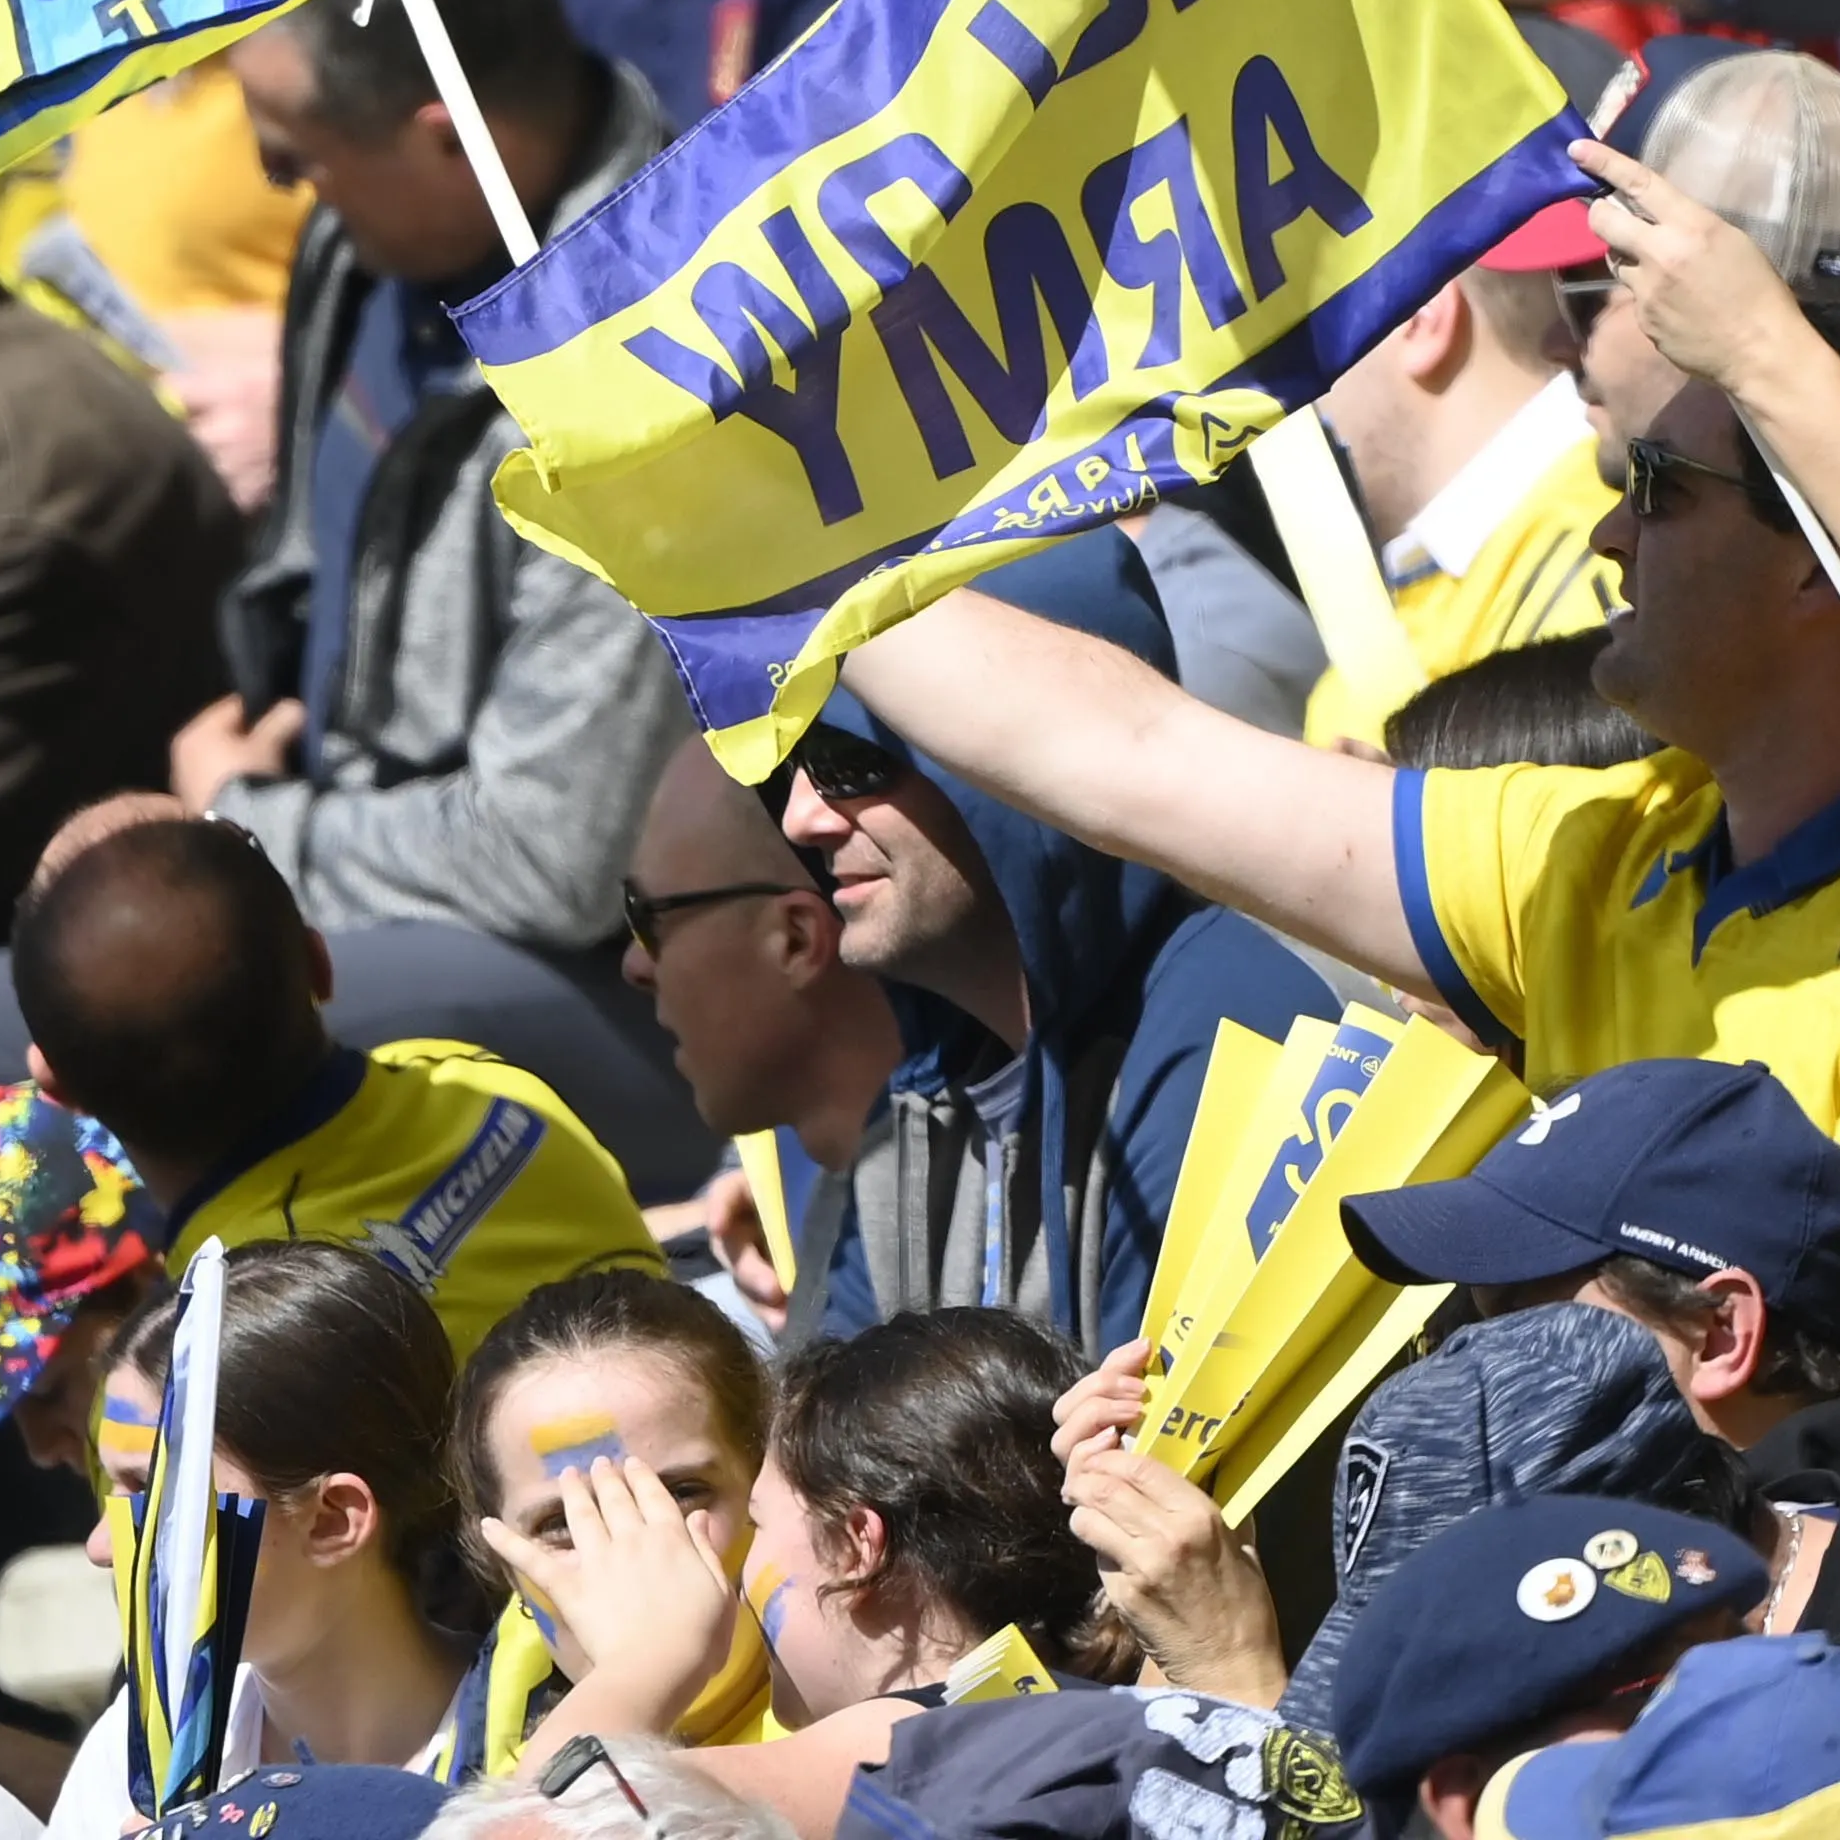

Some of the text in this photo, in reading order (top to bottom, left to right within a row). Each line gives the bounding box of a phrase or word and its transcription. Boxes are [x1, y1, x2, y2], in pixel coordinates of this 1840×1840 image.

[411, 1104, 531, 1247] MICHELIN
[1620, 1221, 1737, 1271] UNDER ARMO
